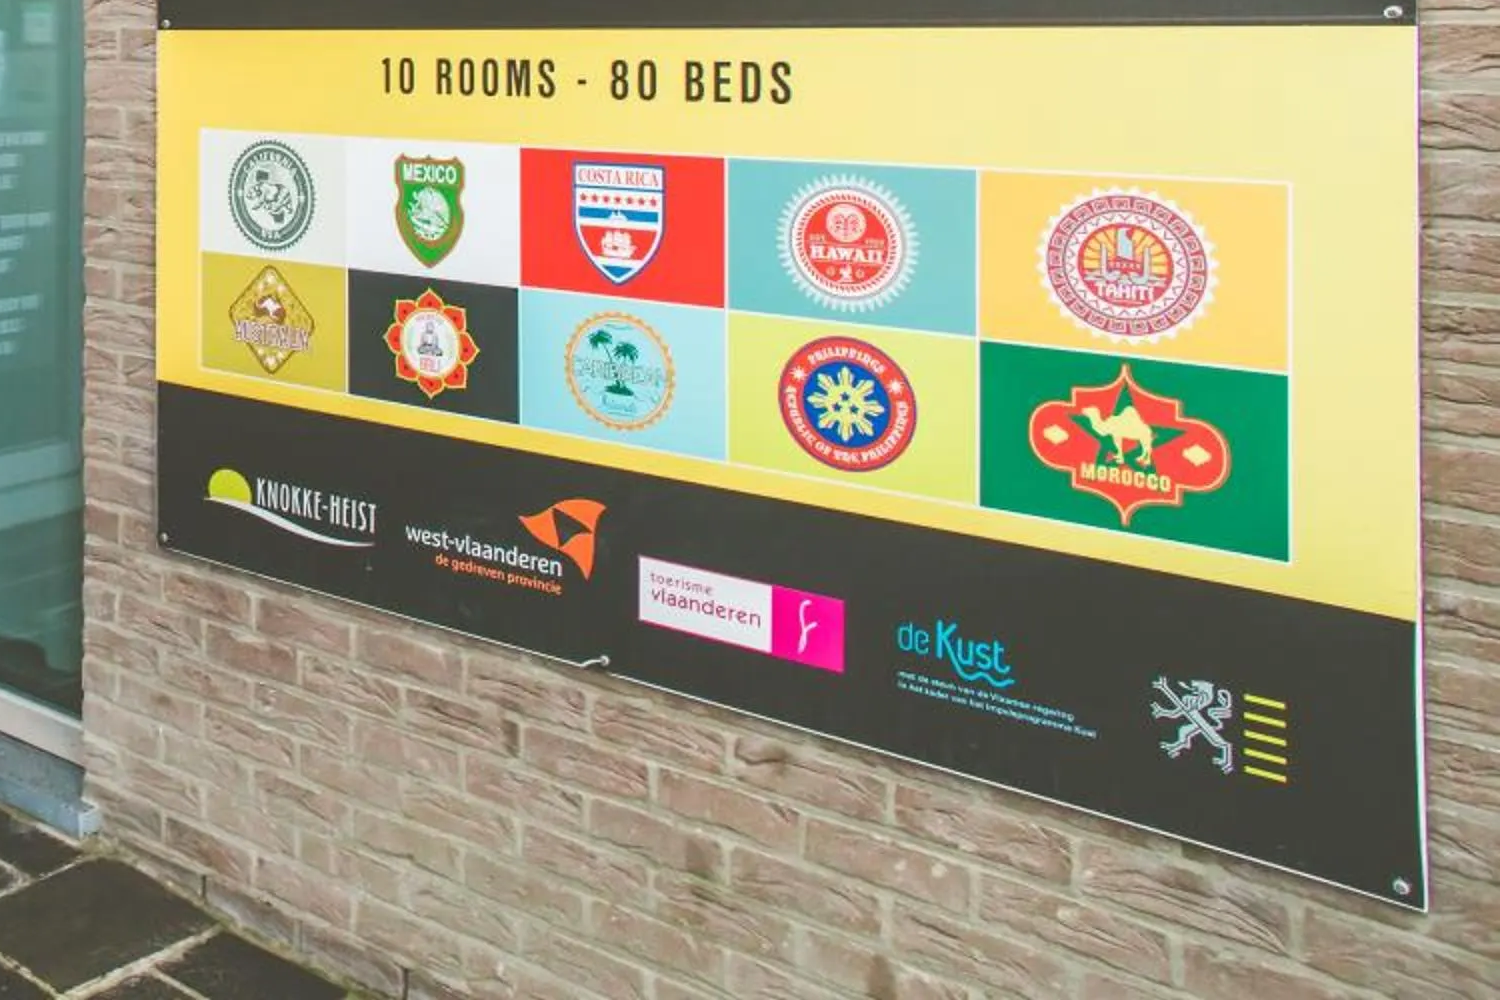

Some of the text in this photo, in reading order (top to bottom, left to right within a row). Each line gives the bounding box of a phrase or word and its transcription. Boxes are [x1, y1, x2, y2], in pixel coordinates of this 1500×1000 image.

[381, 57, 415, 95] 10
[435, 57, 556, 98] ROOMS
[610, 59, 658, 101] 80
[684, 60, 793, 105] BEDS
[403, 163, 457, 184] MEXICO
[579, 167, 659, 187] COSTA RICA
[810, 245, 885, 265] HAWAII
[1094, 280, 1155, 301] TAHITI
[1081, 461, 1172, 493] MOROCCO
[256, 477, 377, 534] KNOKKE-HEIST
[405, 525, 563, 577] west-vlaanderen
[435, 552, 562, 596] de gedreven provincie
[650, 571, 713, 595] toerisme
[651, 587, 761, 628] vlaanderen
[897, 620, 1013, 682] de Kust
